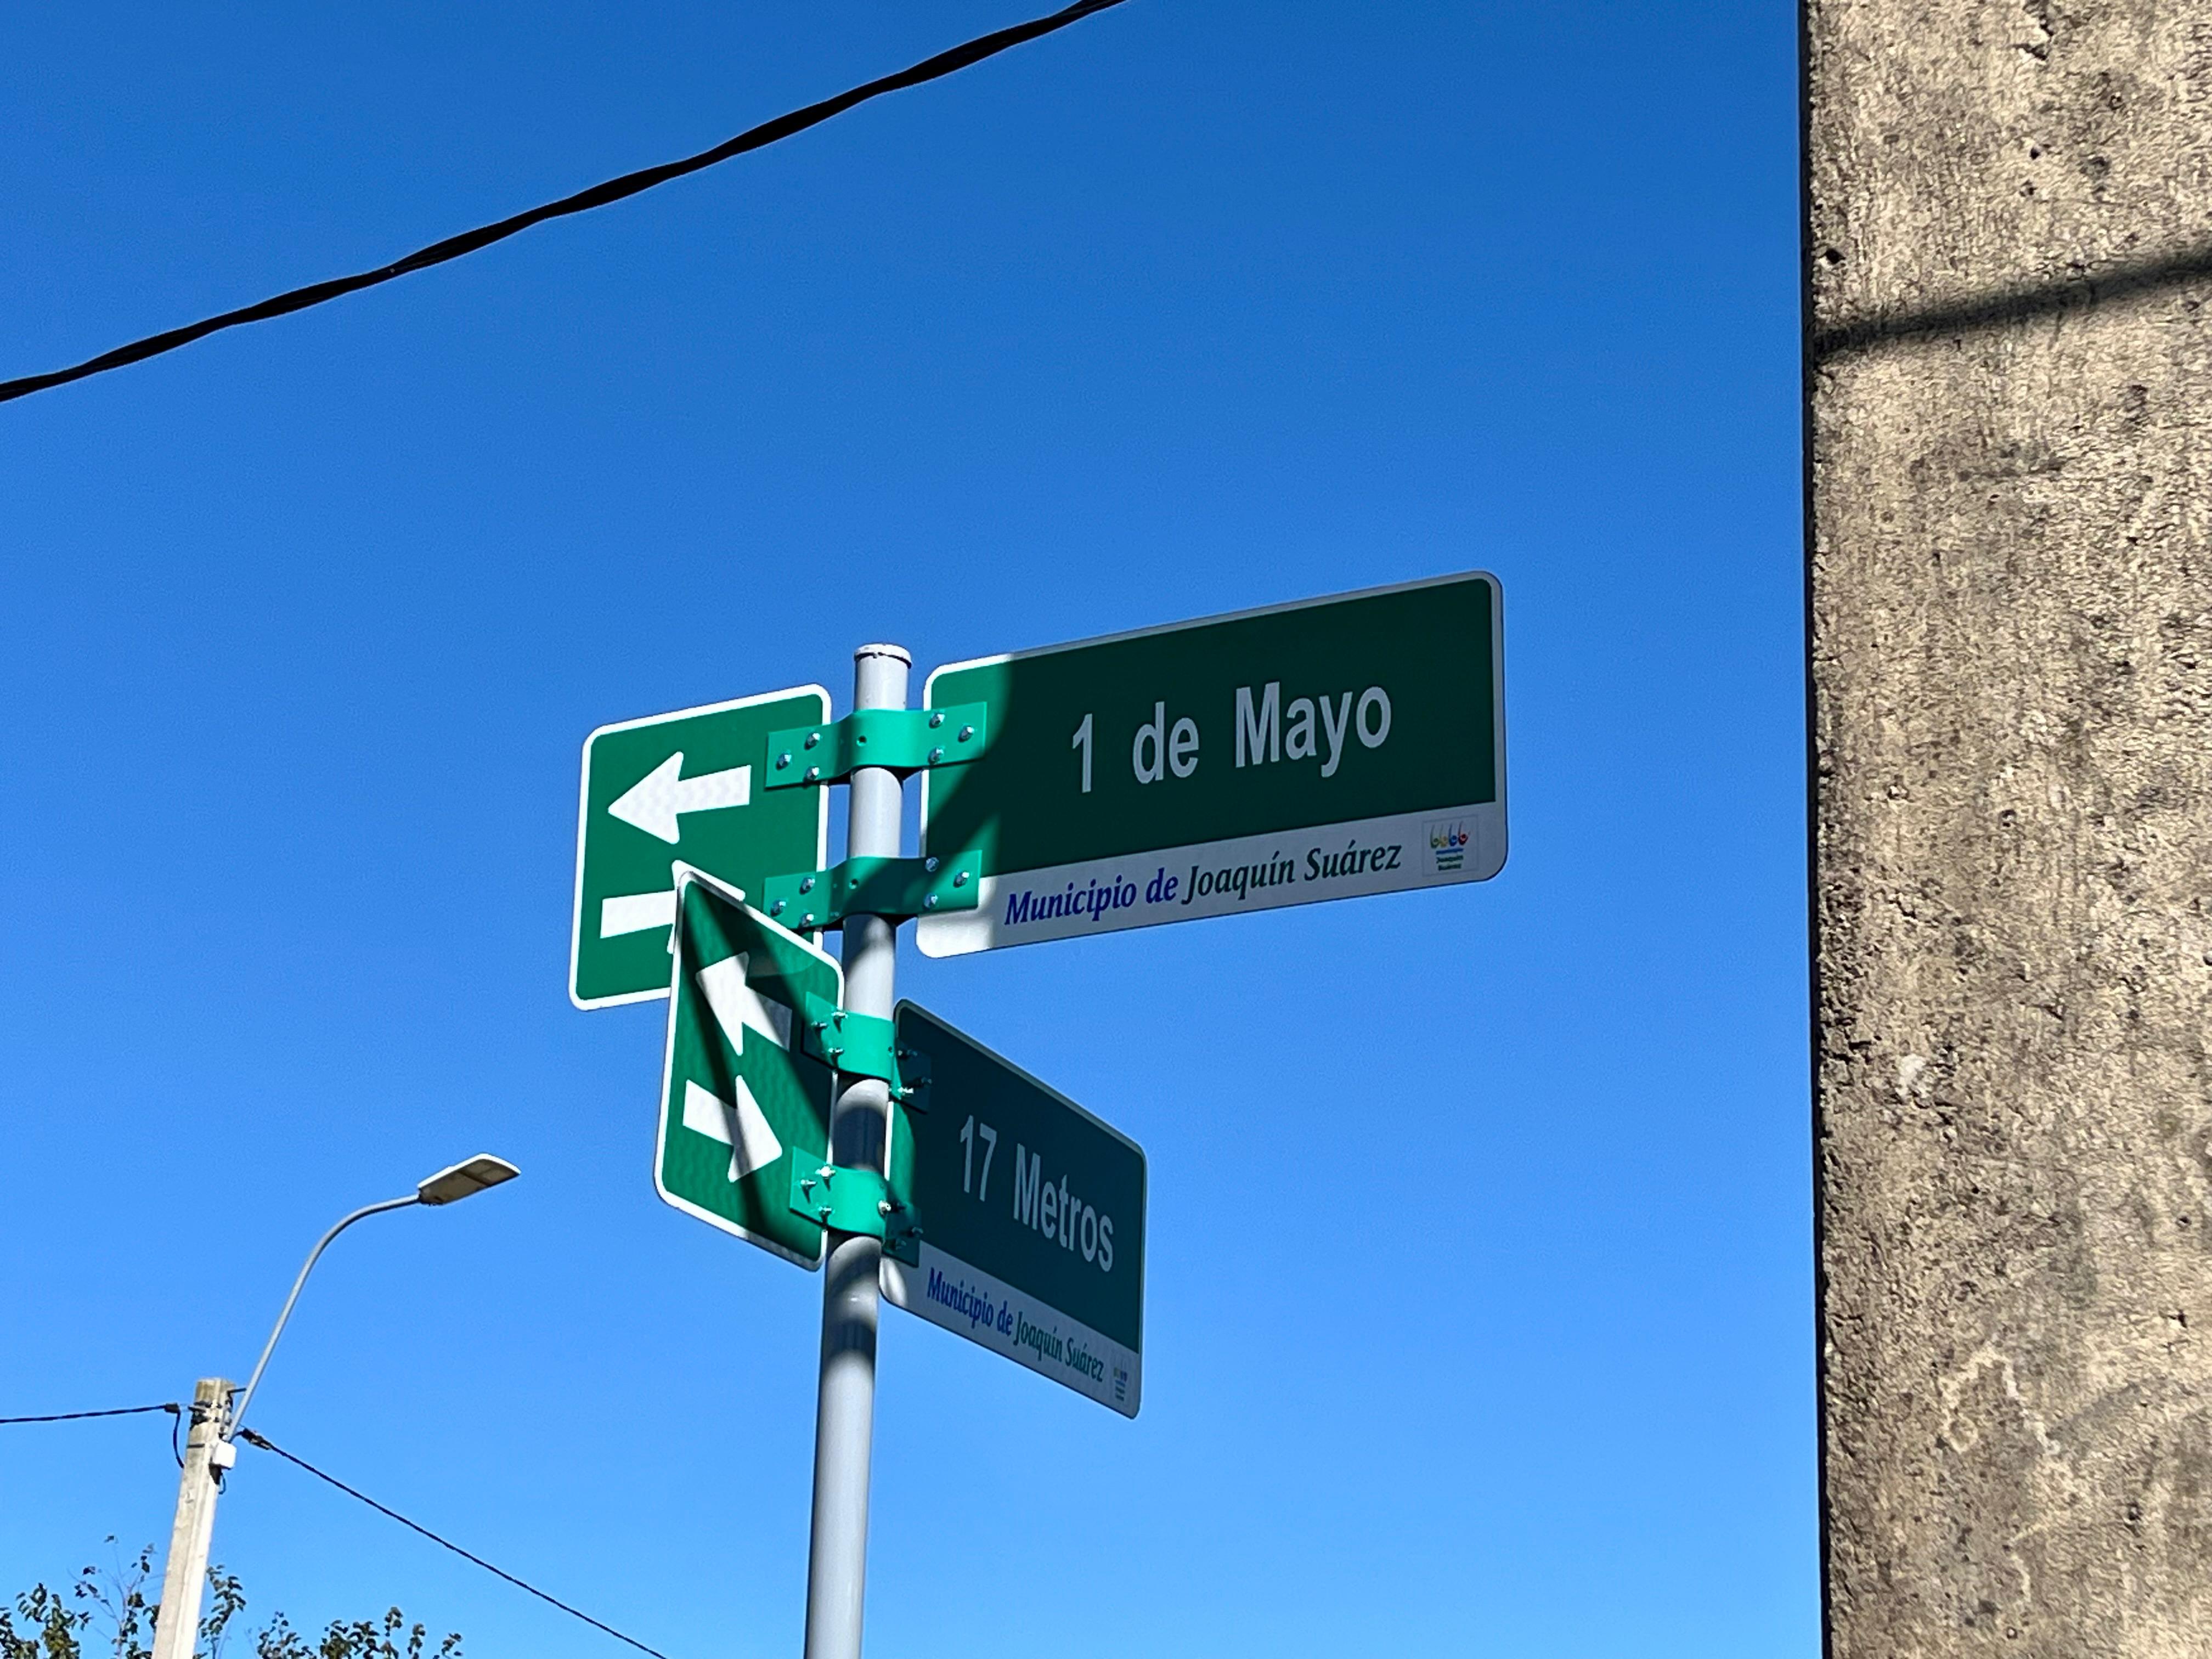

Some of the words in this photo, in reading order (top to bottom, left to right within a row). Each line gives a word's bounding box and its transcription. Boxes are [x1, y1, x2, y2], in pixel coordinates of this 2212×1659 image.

[1073, 713, 1092, 793] 1
[1133, 701, 1199, 784] de
[1235, 682, 1391, 777] Mayo
[1005, 874, 1136, 925] Municipio
[1145, 868, 1178, 904] de
[1181, 851, 1295, 905] Joaquín
[1304, 840, 1401, 882] Suárez
[960, 1115, 997, 1201] 17
[1013, 1143, 1113, 1272] Metros
[927, 1267, 994, 1329] Municipio
[997, 1300, 1013, 1336] de
[1013, 1311, 1063, 1362] Joaquín
[1066, 1337, 1104, 1383] Suárez
